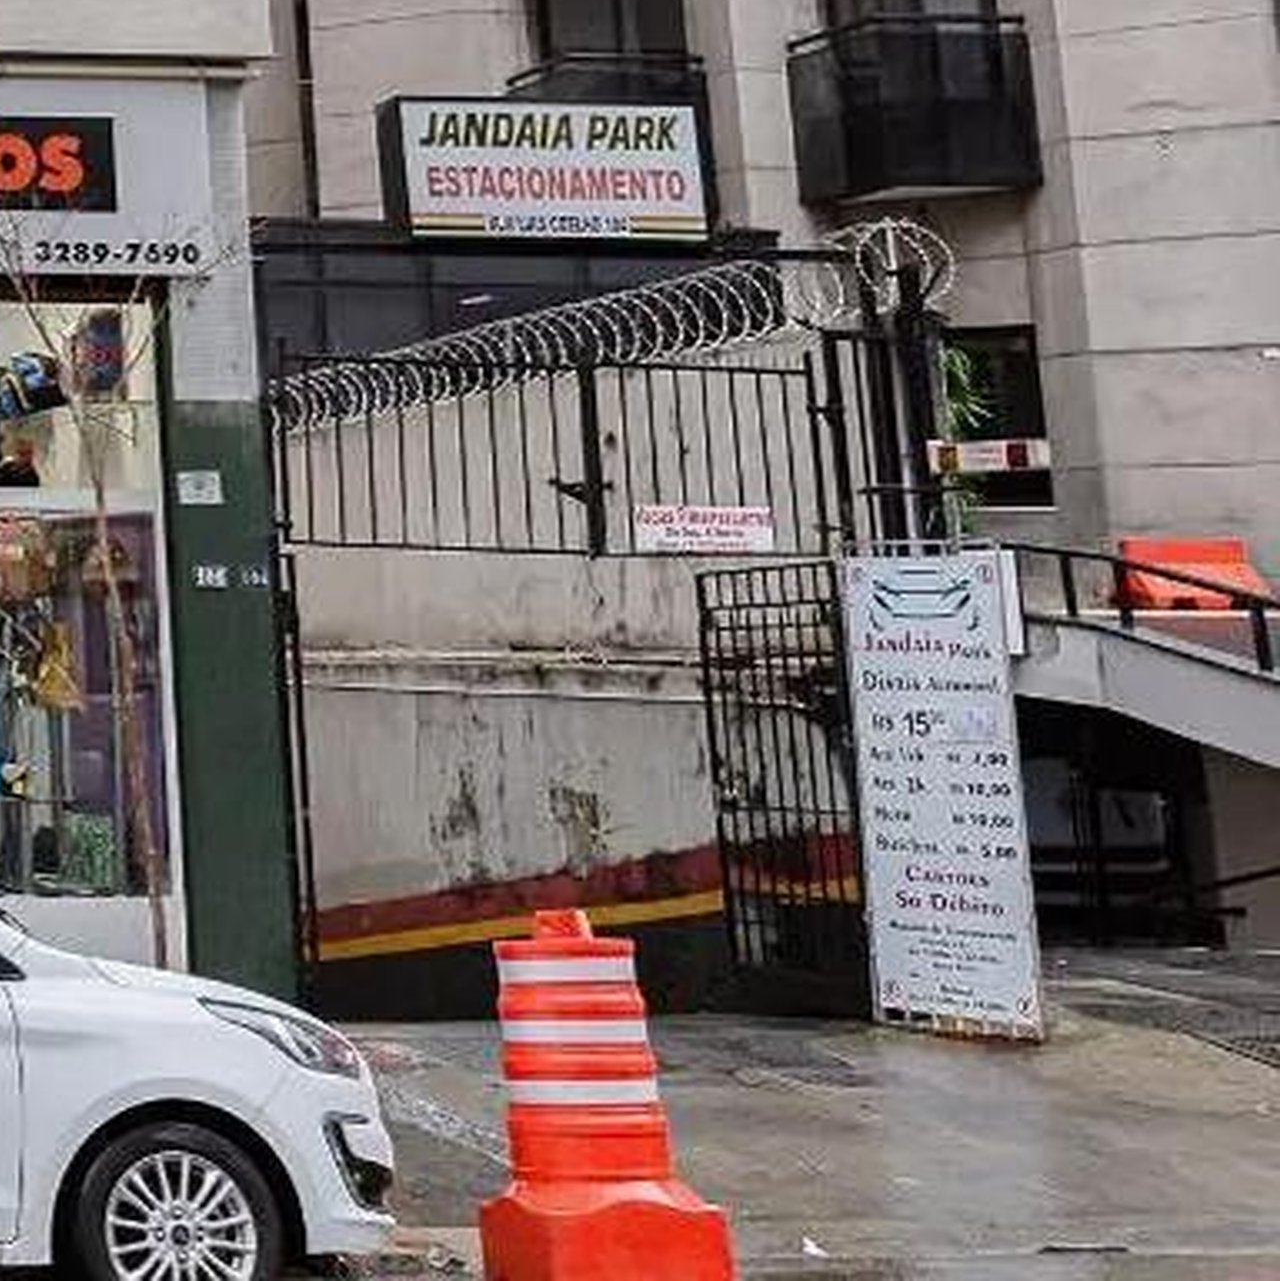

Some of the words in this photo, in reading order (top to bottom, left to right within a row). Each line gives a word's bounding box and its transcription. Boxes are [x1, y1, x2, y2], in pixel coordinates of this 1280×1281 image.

[418, 112, 574, 149] JANDAIA
[586, 115, 678, 150] PARK
[426, 165, 686, 202] ESTACIONAMENTO
